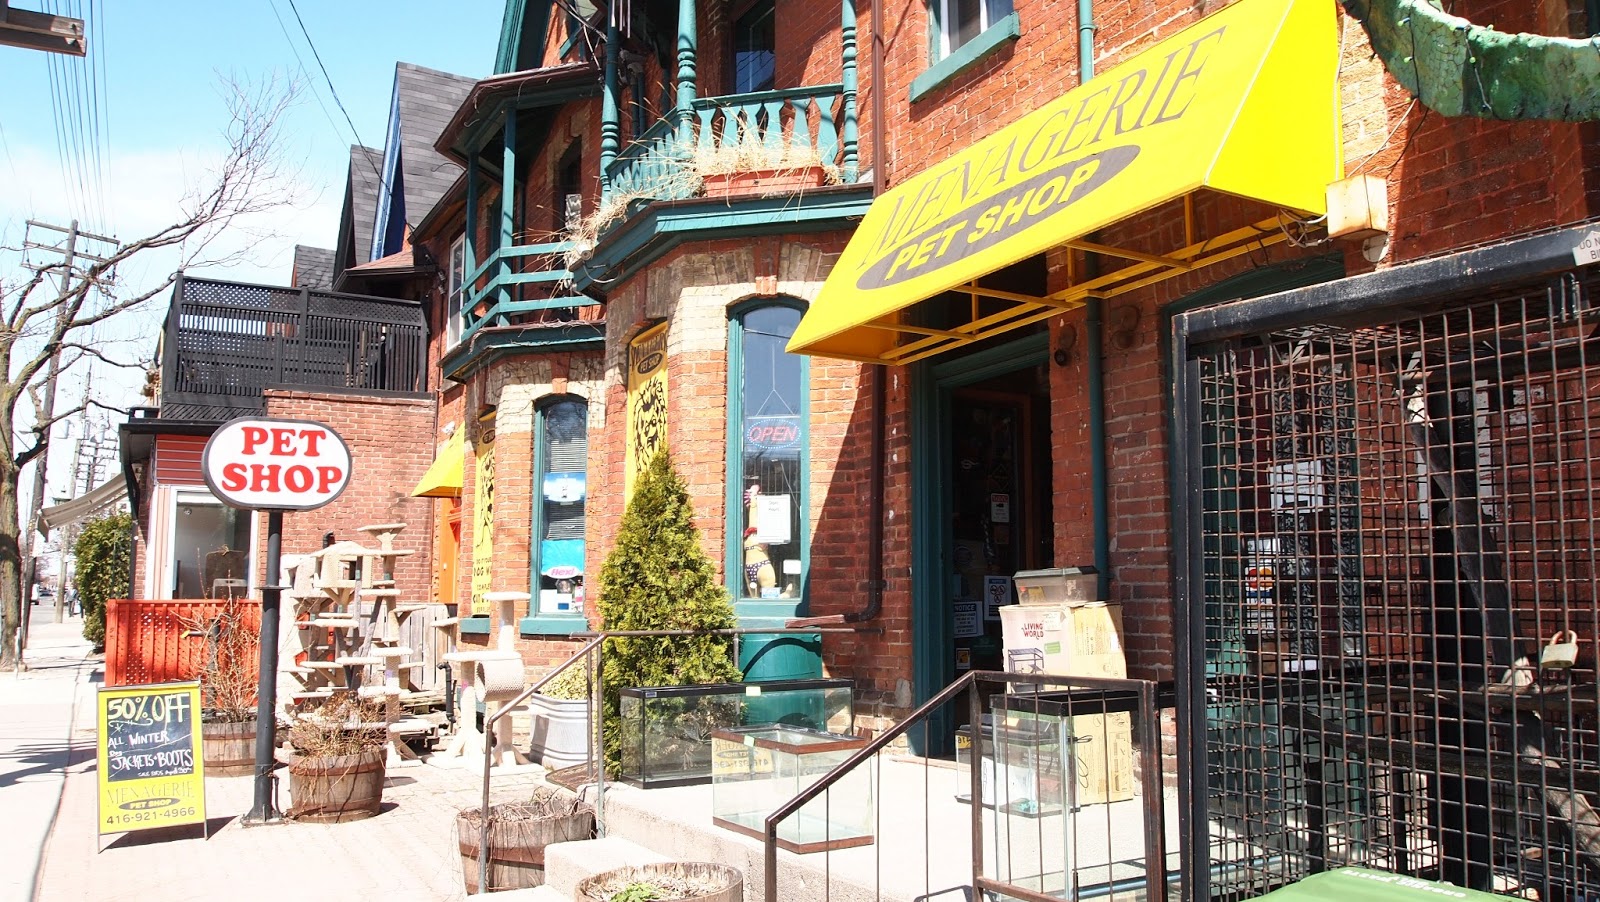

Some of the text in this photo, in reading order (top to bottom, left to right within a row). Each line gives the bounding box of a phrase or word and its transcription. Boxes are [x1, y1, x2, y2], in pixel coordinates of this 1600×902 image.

[857, 26, 1227, 271] MENAGERIE
[884, 158, 1103, 281] PET SHOP
[241, 426, 326, 457] PET
[749, 426, 797, 442] OPEN
[222, 462, 342, 494] SHOP
[1023, 630, 1044, 638] WORLD
[108, 693, 190, 723] 50% OFF
[128, 730, 170, 747] WINTER
[107, 781, 195, 805] MENAGERIE
[129, 798, 172, 809] PET SHOP
[107, 808, 195, 824] 416-921-4966
